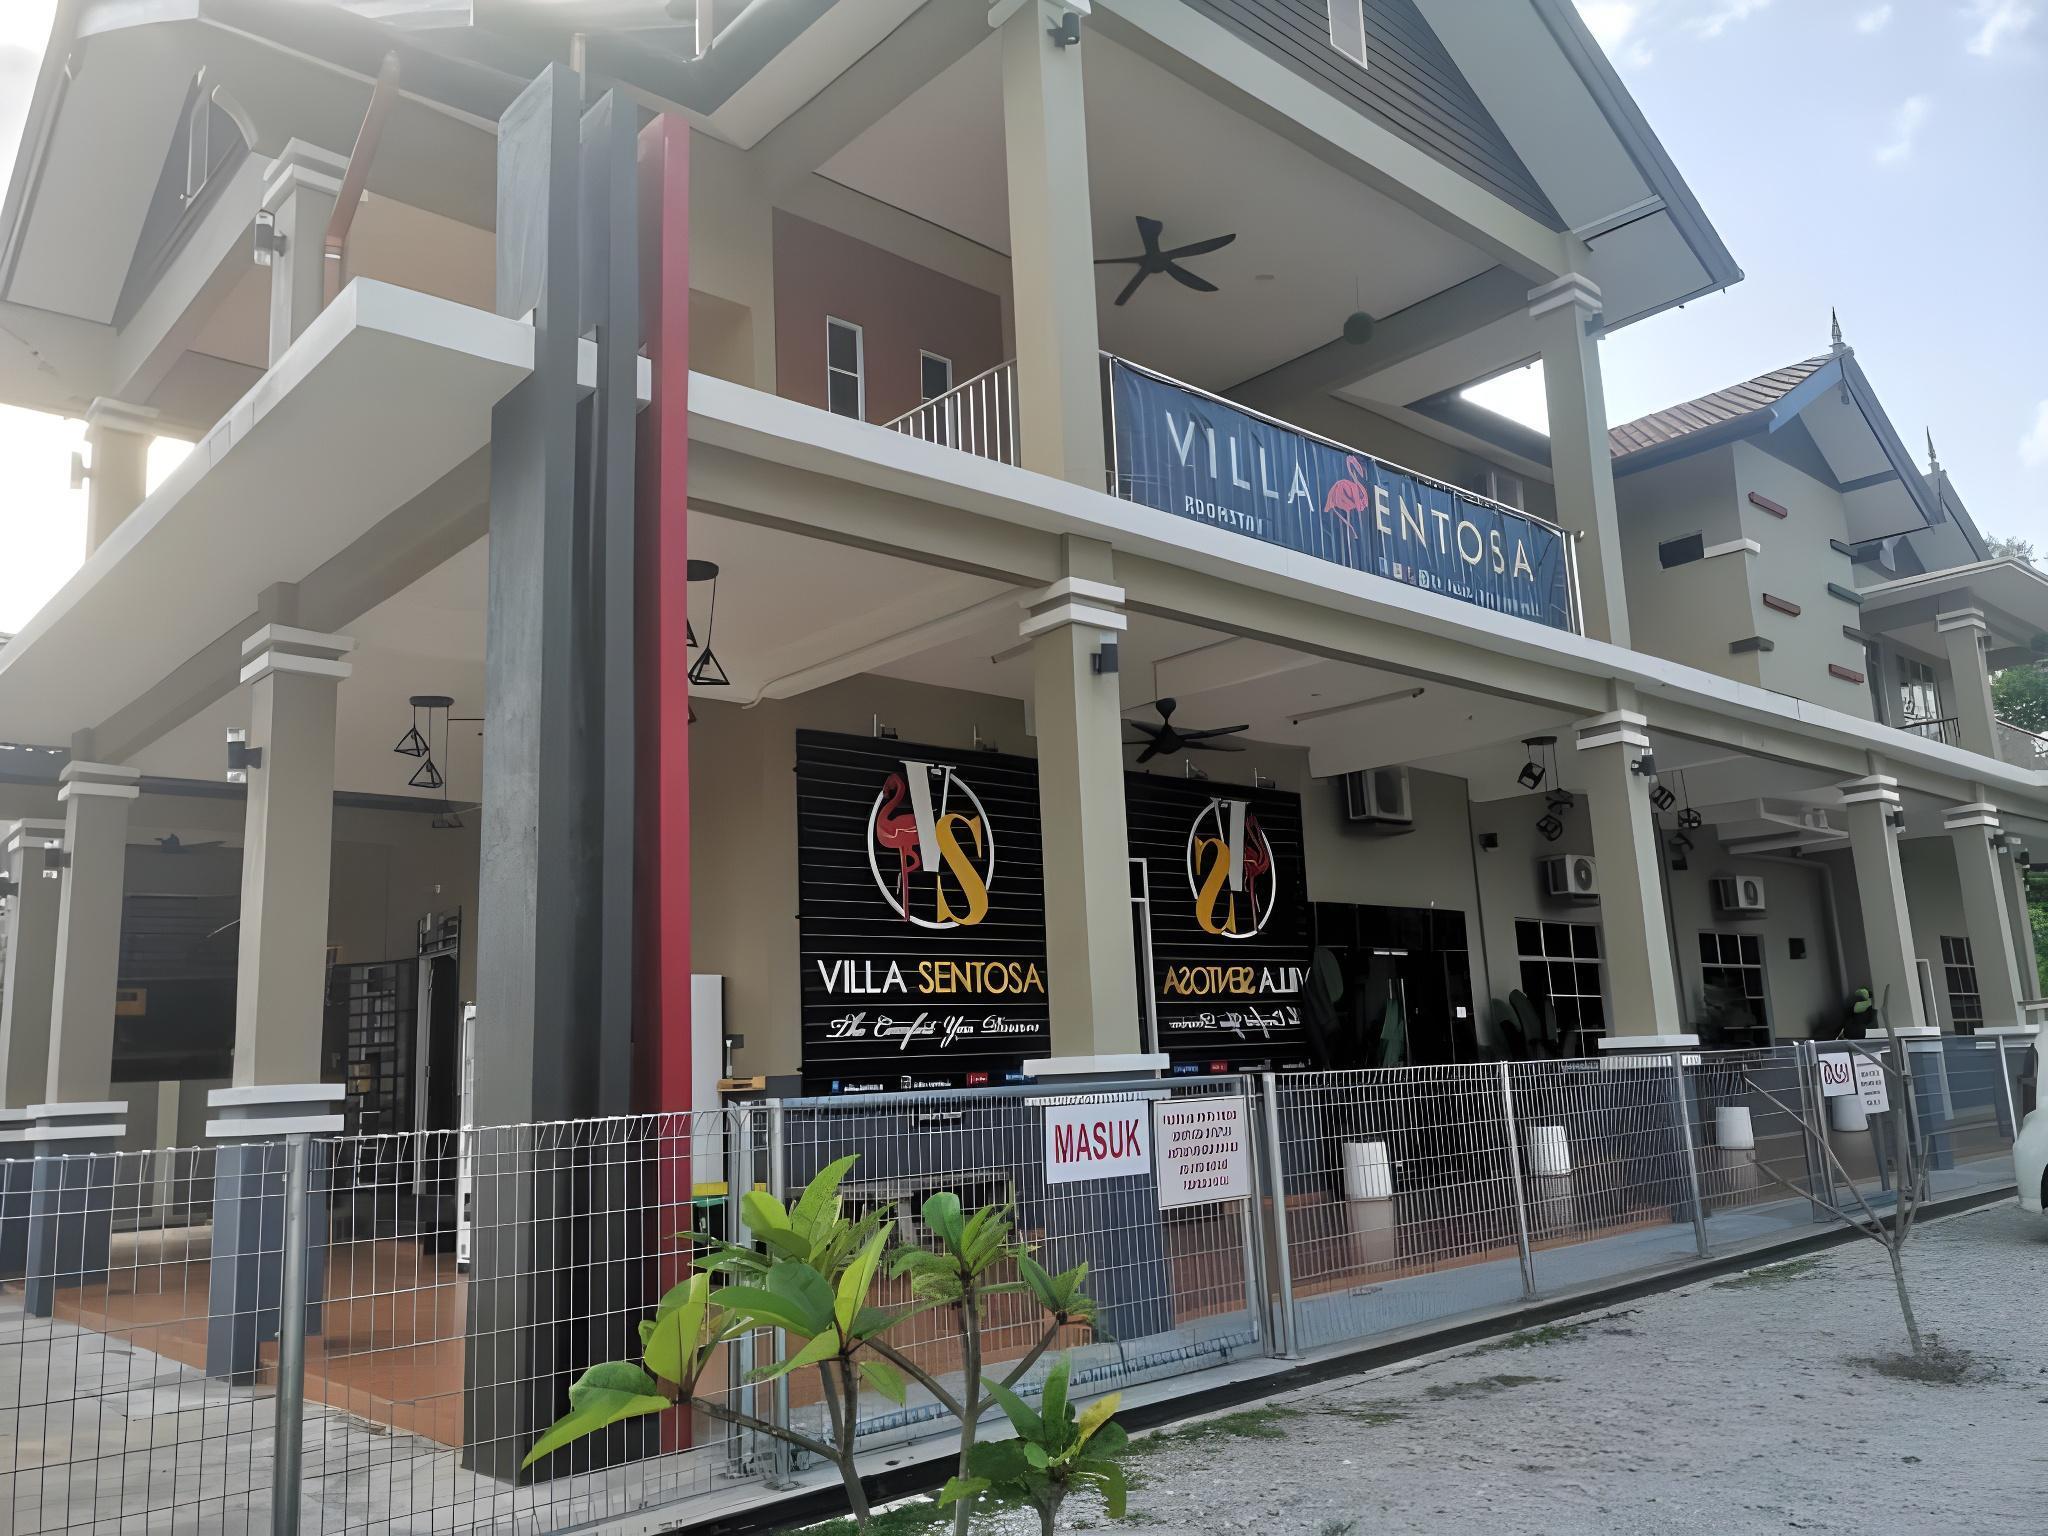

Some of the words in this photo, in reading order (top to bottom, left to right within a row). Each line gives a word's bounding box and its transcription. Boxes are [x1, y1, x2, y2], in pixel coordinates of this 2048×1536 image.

[1165, 409, 1315, 513] VILLA
[817, 959, 908, 995] VILLA
[918, 961, 1045, 995] SENTOSA
[1055, 1119, 1141, 1164] MASUK
